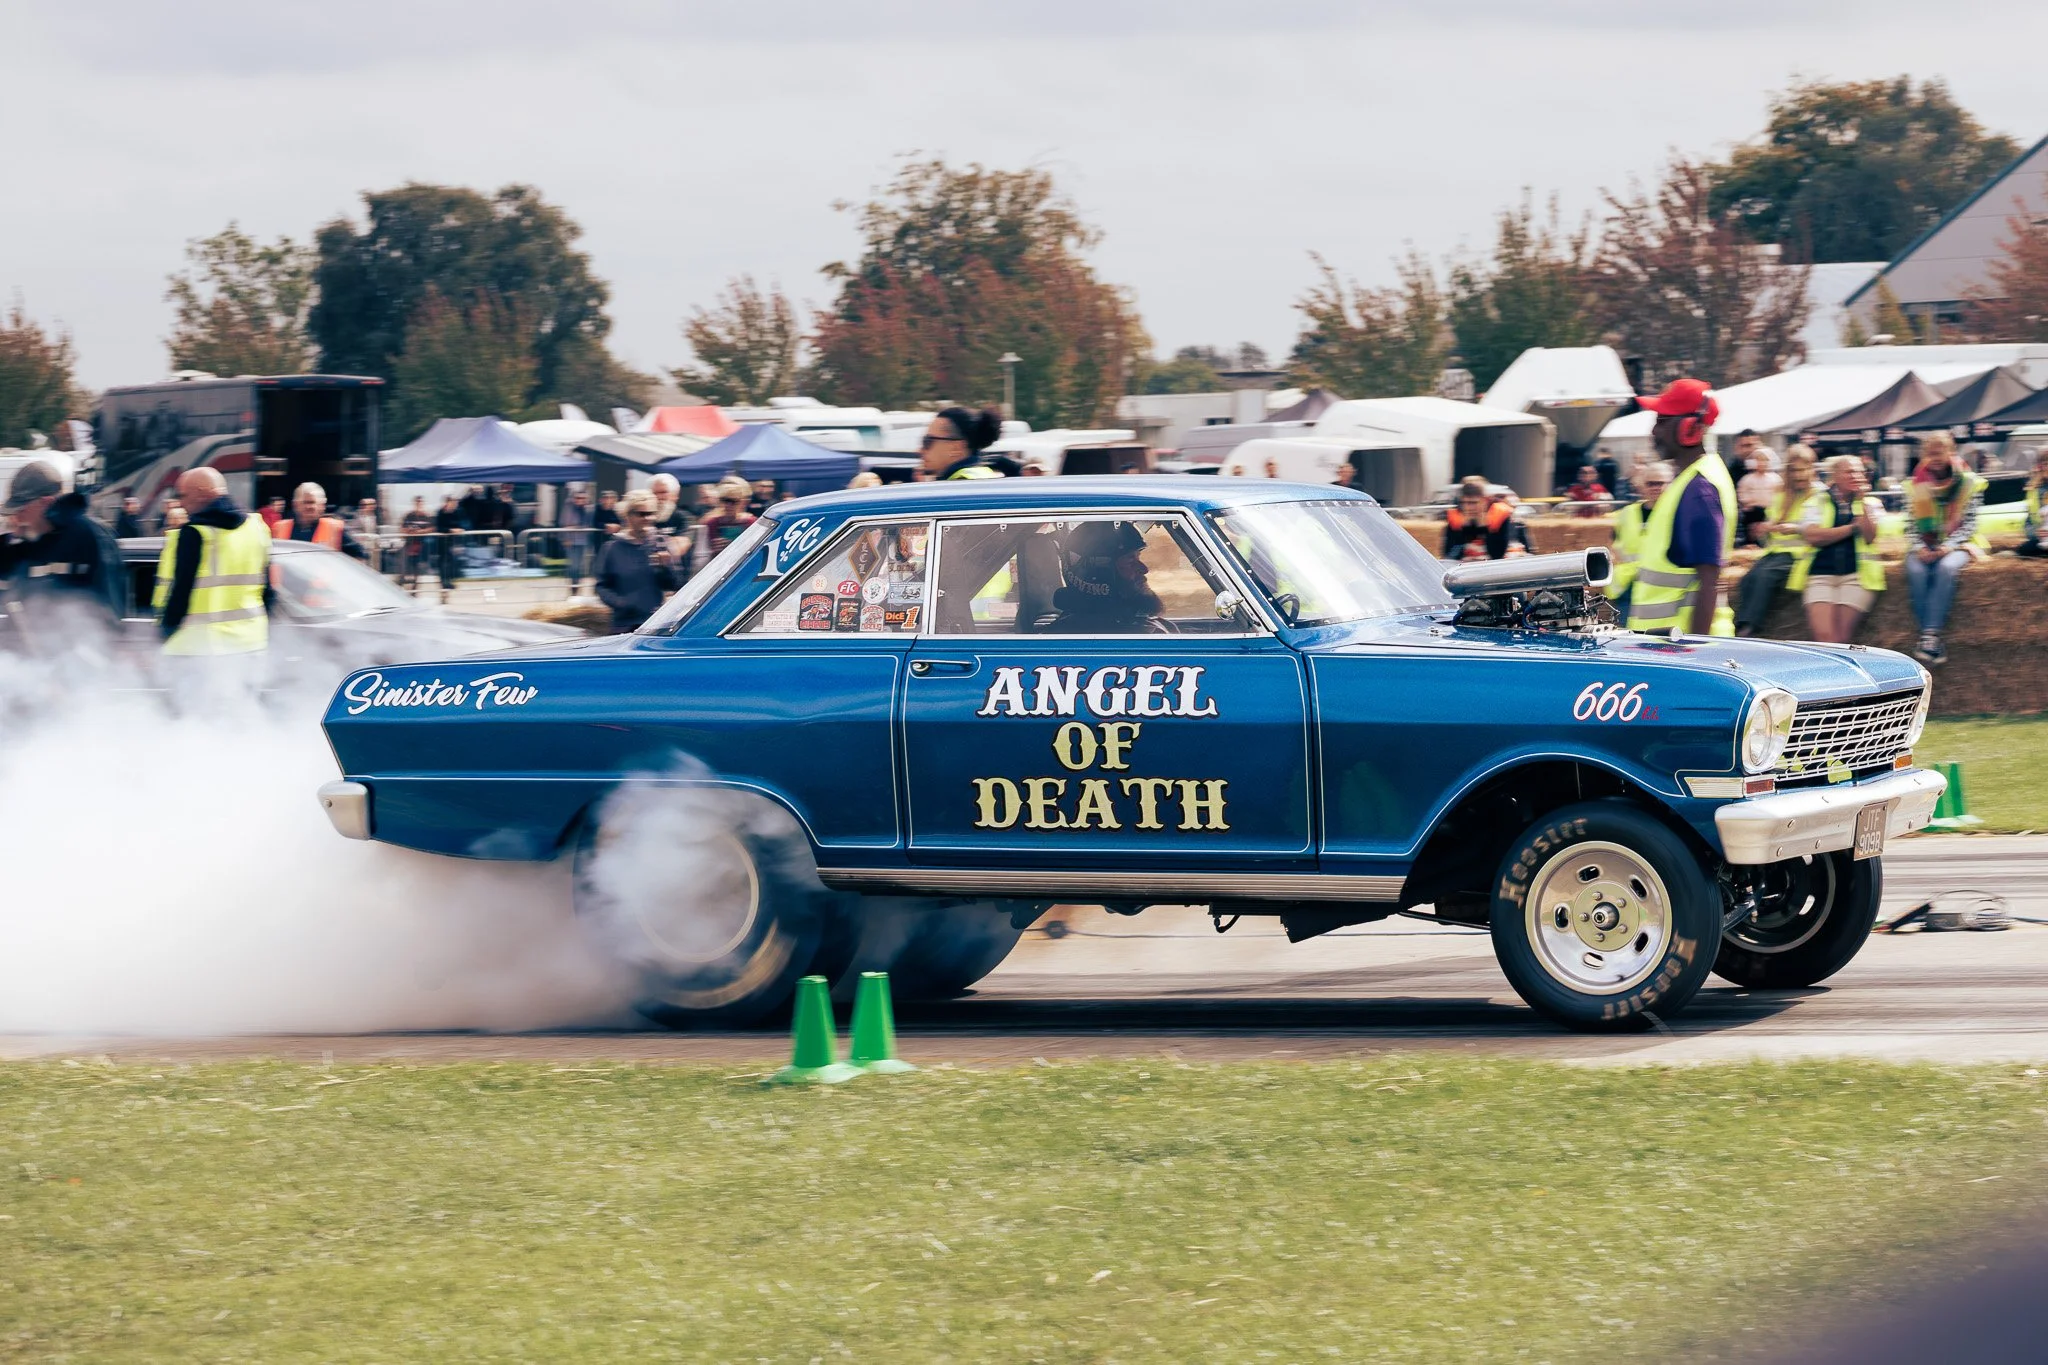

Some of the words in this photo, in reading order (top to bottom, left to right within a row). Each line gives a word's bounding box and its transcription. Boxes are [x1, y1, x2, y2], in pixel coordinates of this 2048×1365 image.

[839, 582, 857, 594] FTC
[344, 672, 470, 715] Sinister
[469, 672, 539, 710] Few
[975, 665, 1219, 718] ANGEL
[1573, 681, 1649, 721] 666
[1051, 721, 1143, 770] OF
[972, 776, 1231, 831] DEATH
[1864, 808, 1881, 831] JTF
[1499, 817, 1588, 910] Hoosier
[1600, 928, 1698, 1021] Hoosier
